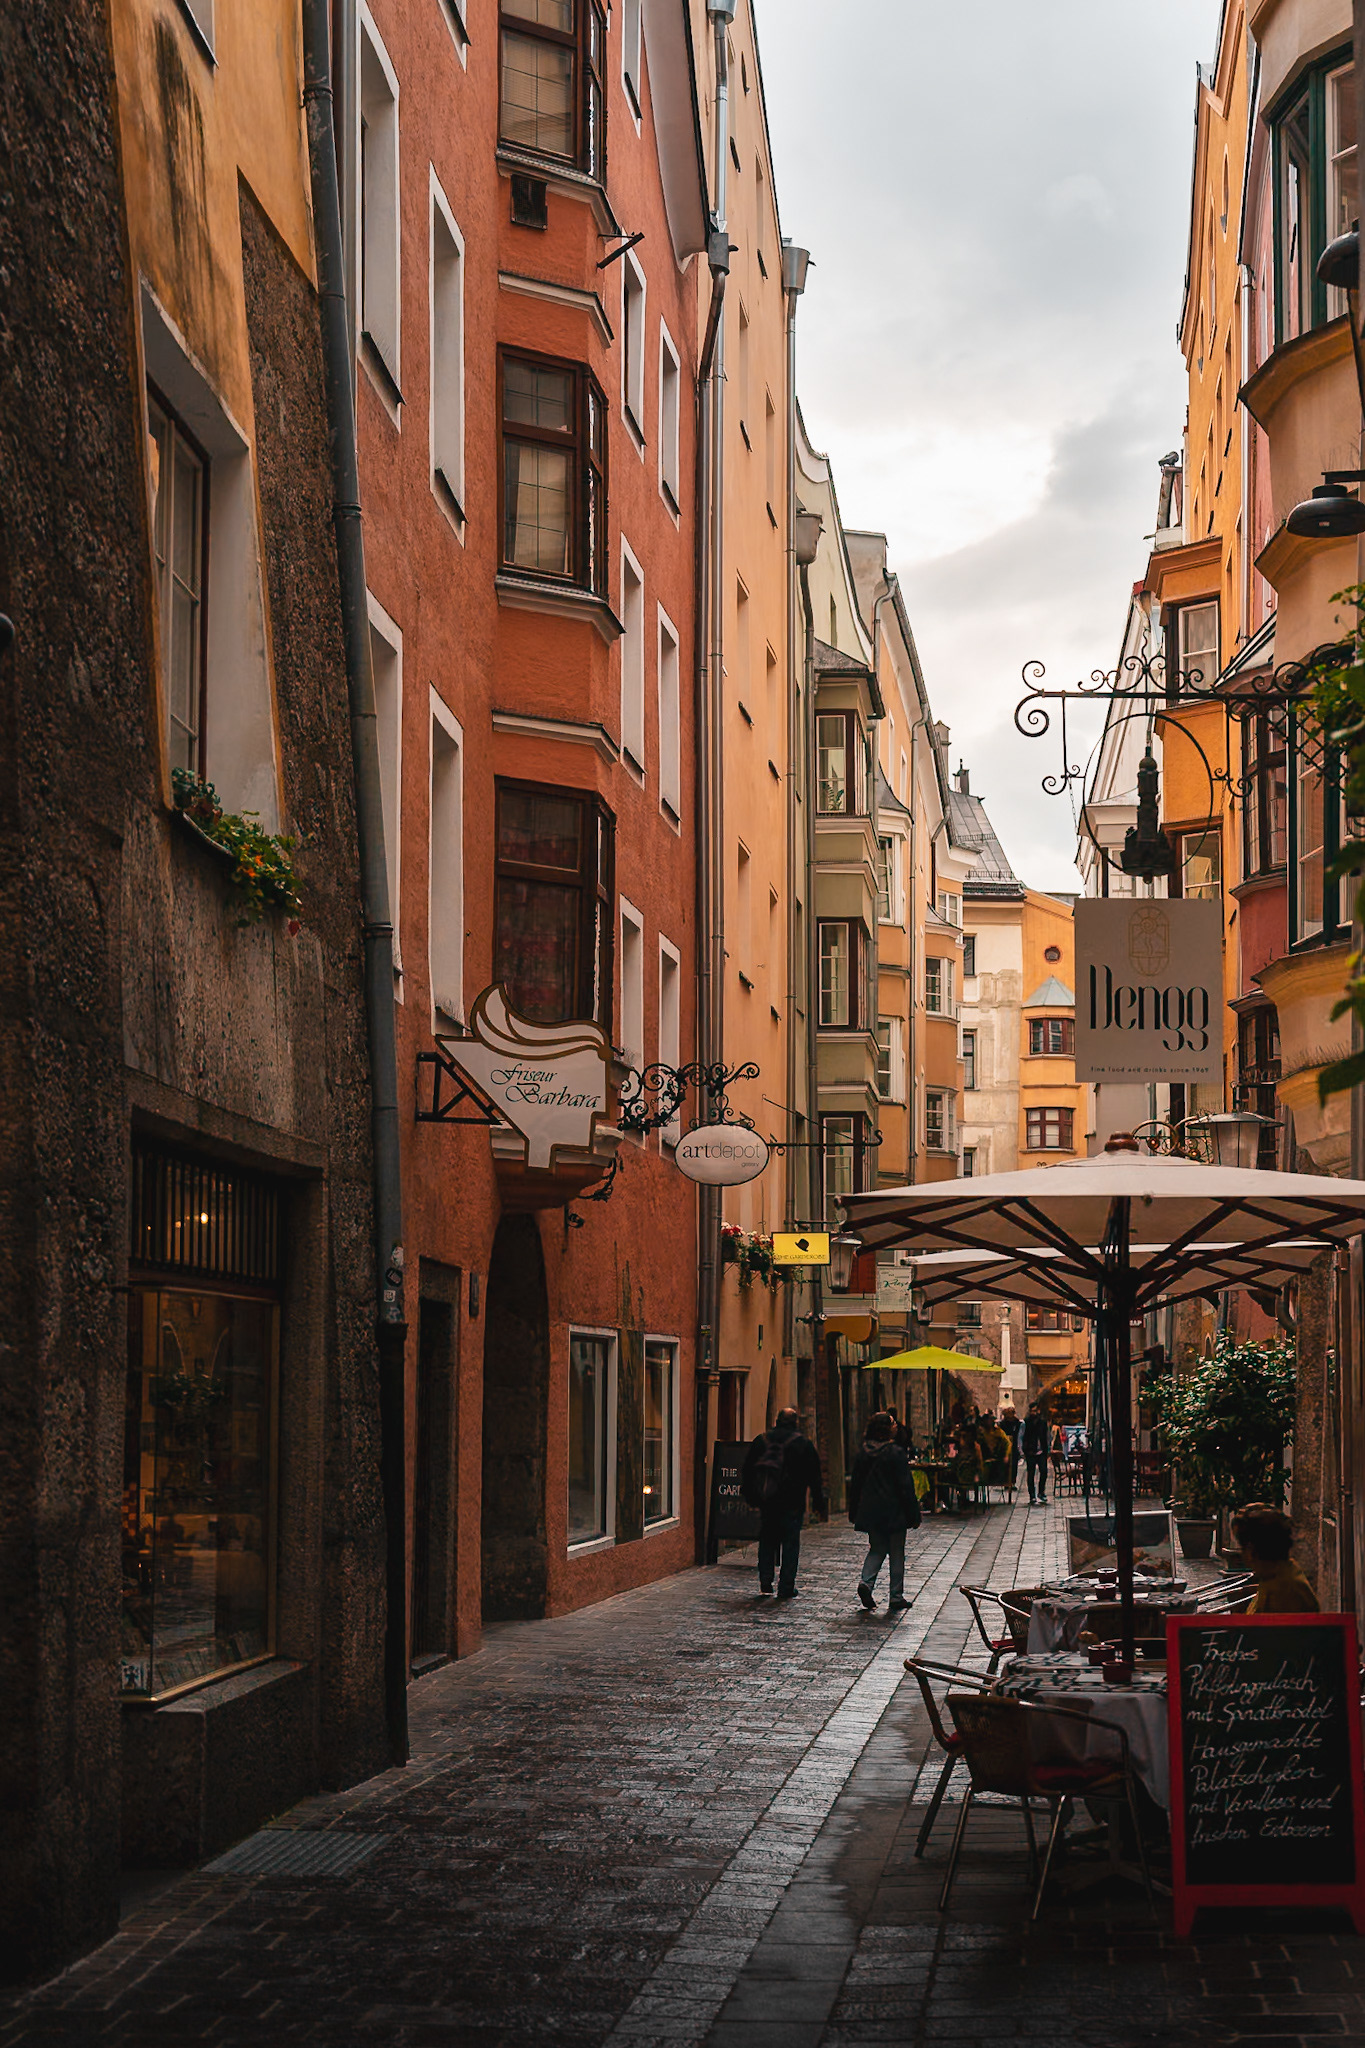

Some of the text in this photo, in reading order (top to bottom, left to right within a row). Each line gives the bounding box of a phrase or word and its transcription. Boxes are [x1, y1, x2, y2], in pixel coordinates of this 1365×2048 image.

[1089, 964, 1209, 1051] Dengg
[490, 1063, 557, 1085] Friseur
[505, 1082, 601, 1108] Barbara
[721, 1467, 737, 1477] THE
[1186, 1701, 1213, 1723] mit
